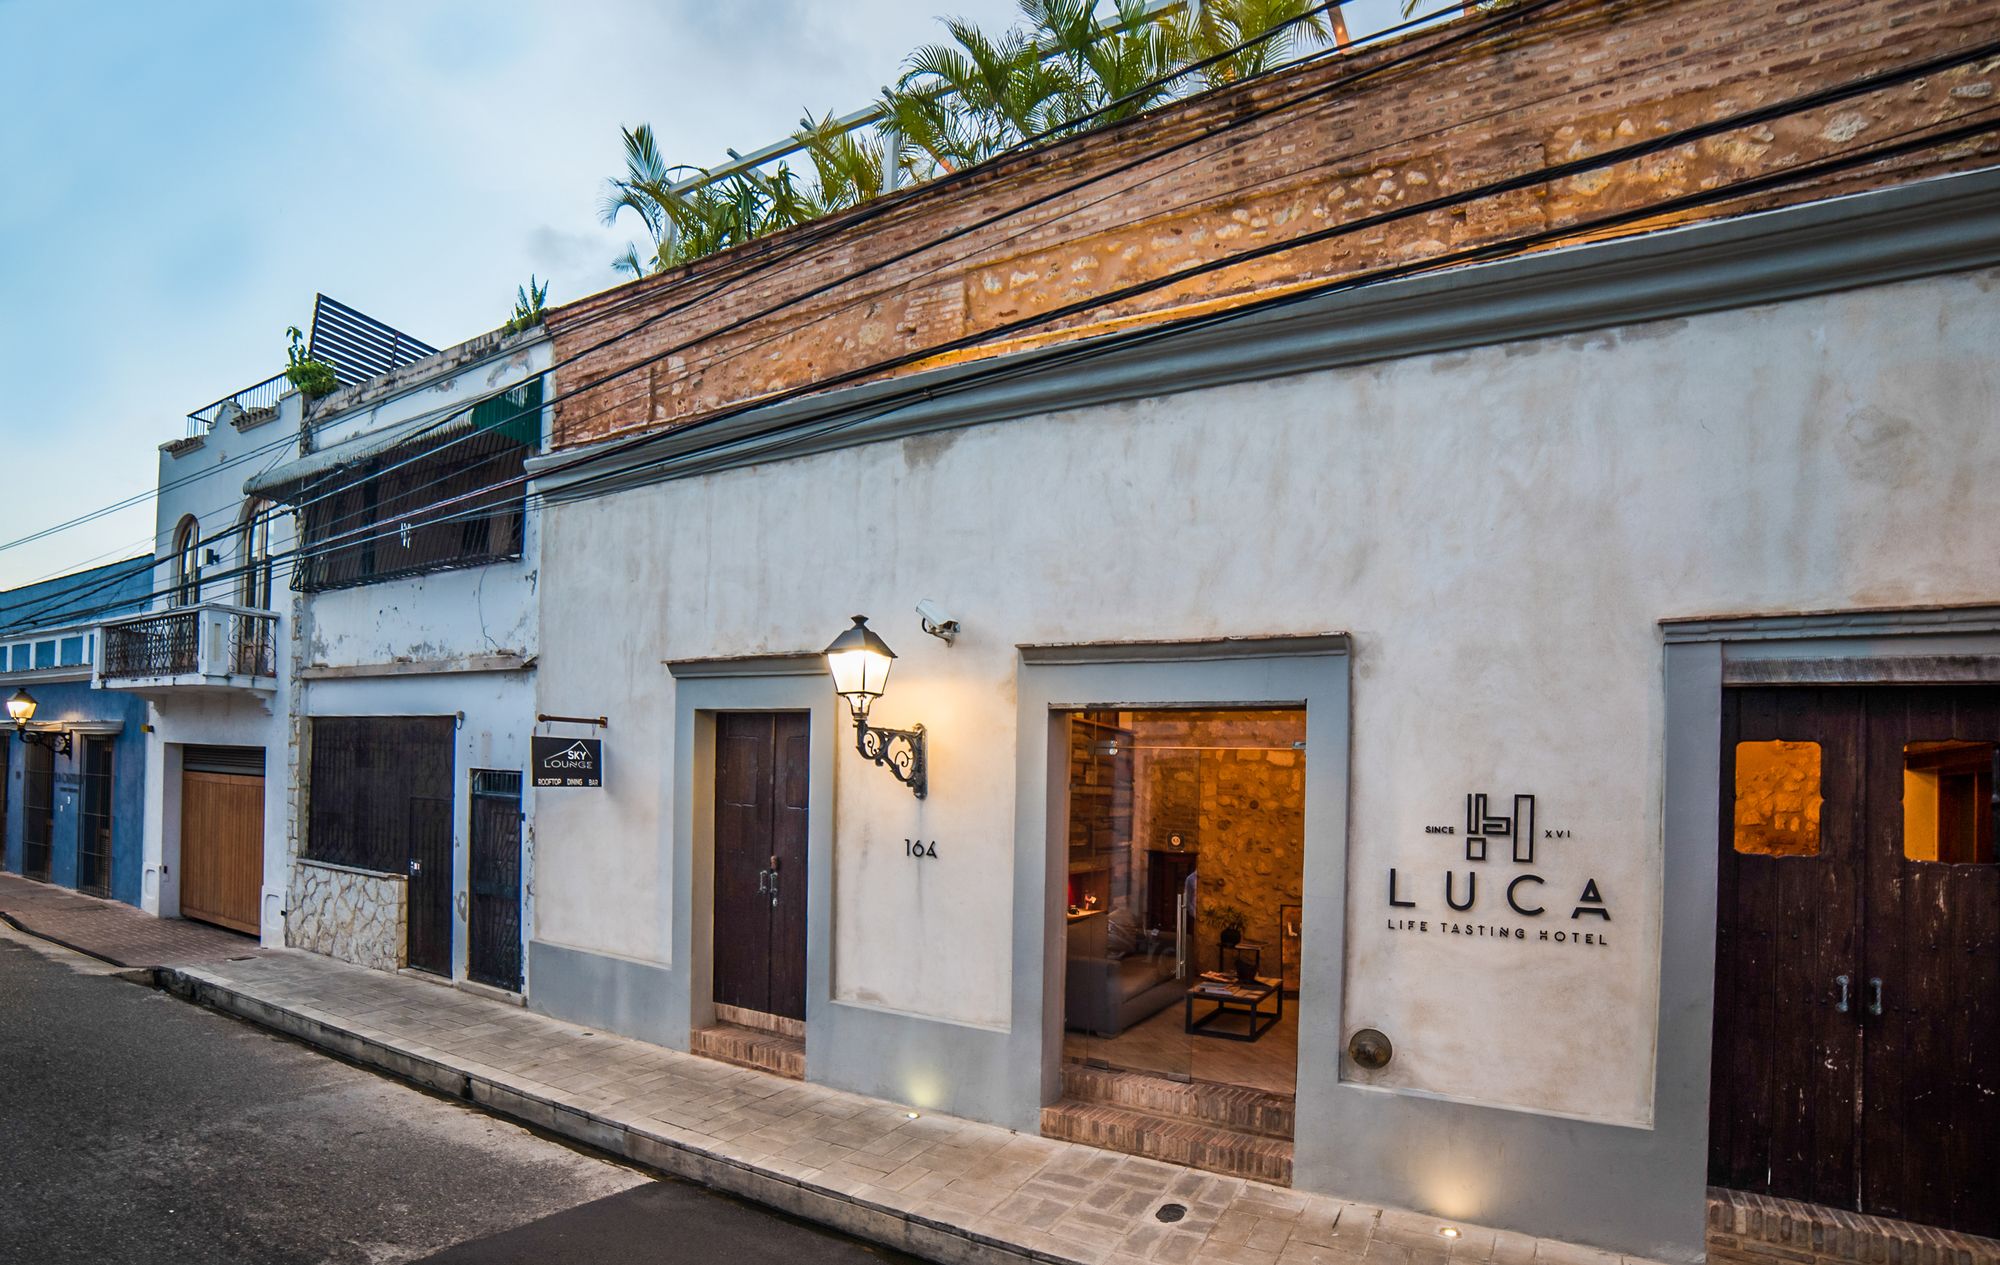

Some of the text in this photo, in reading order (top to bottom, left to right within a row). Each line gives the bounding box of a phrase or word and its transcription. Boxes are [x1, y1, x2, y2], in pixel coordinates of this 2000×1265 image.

[567, 750, 586, 760] SKY
[544, 760, 593, 769] LOUNGE
[538, 778, 599, 786] ROOFTOP DINING BAR
[1425, 825, 1455, 835] SINCE
[904, 838, 938, 859] 164
[1389, 868, 1611, 921] LUCA
[1387, 919, 1608, 945] LIFE TASTING HOTEL
